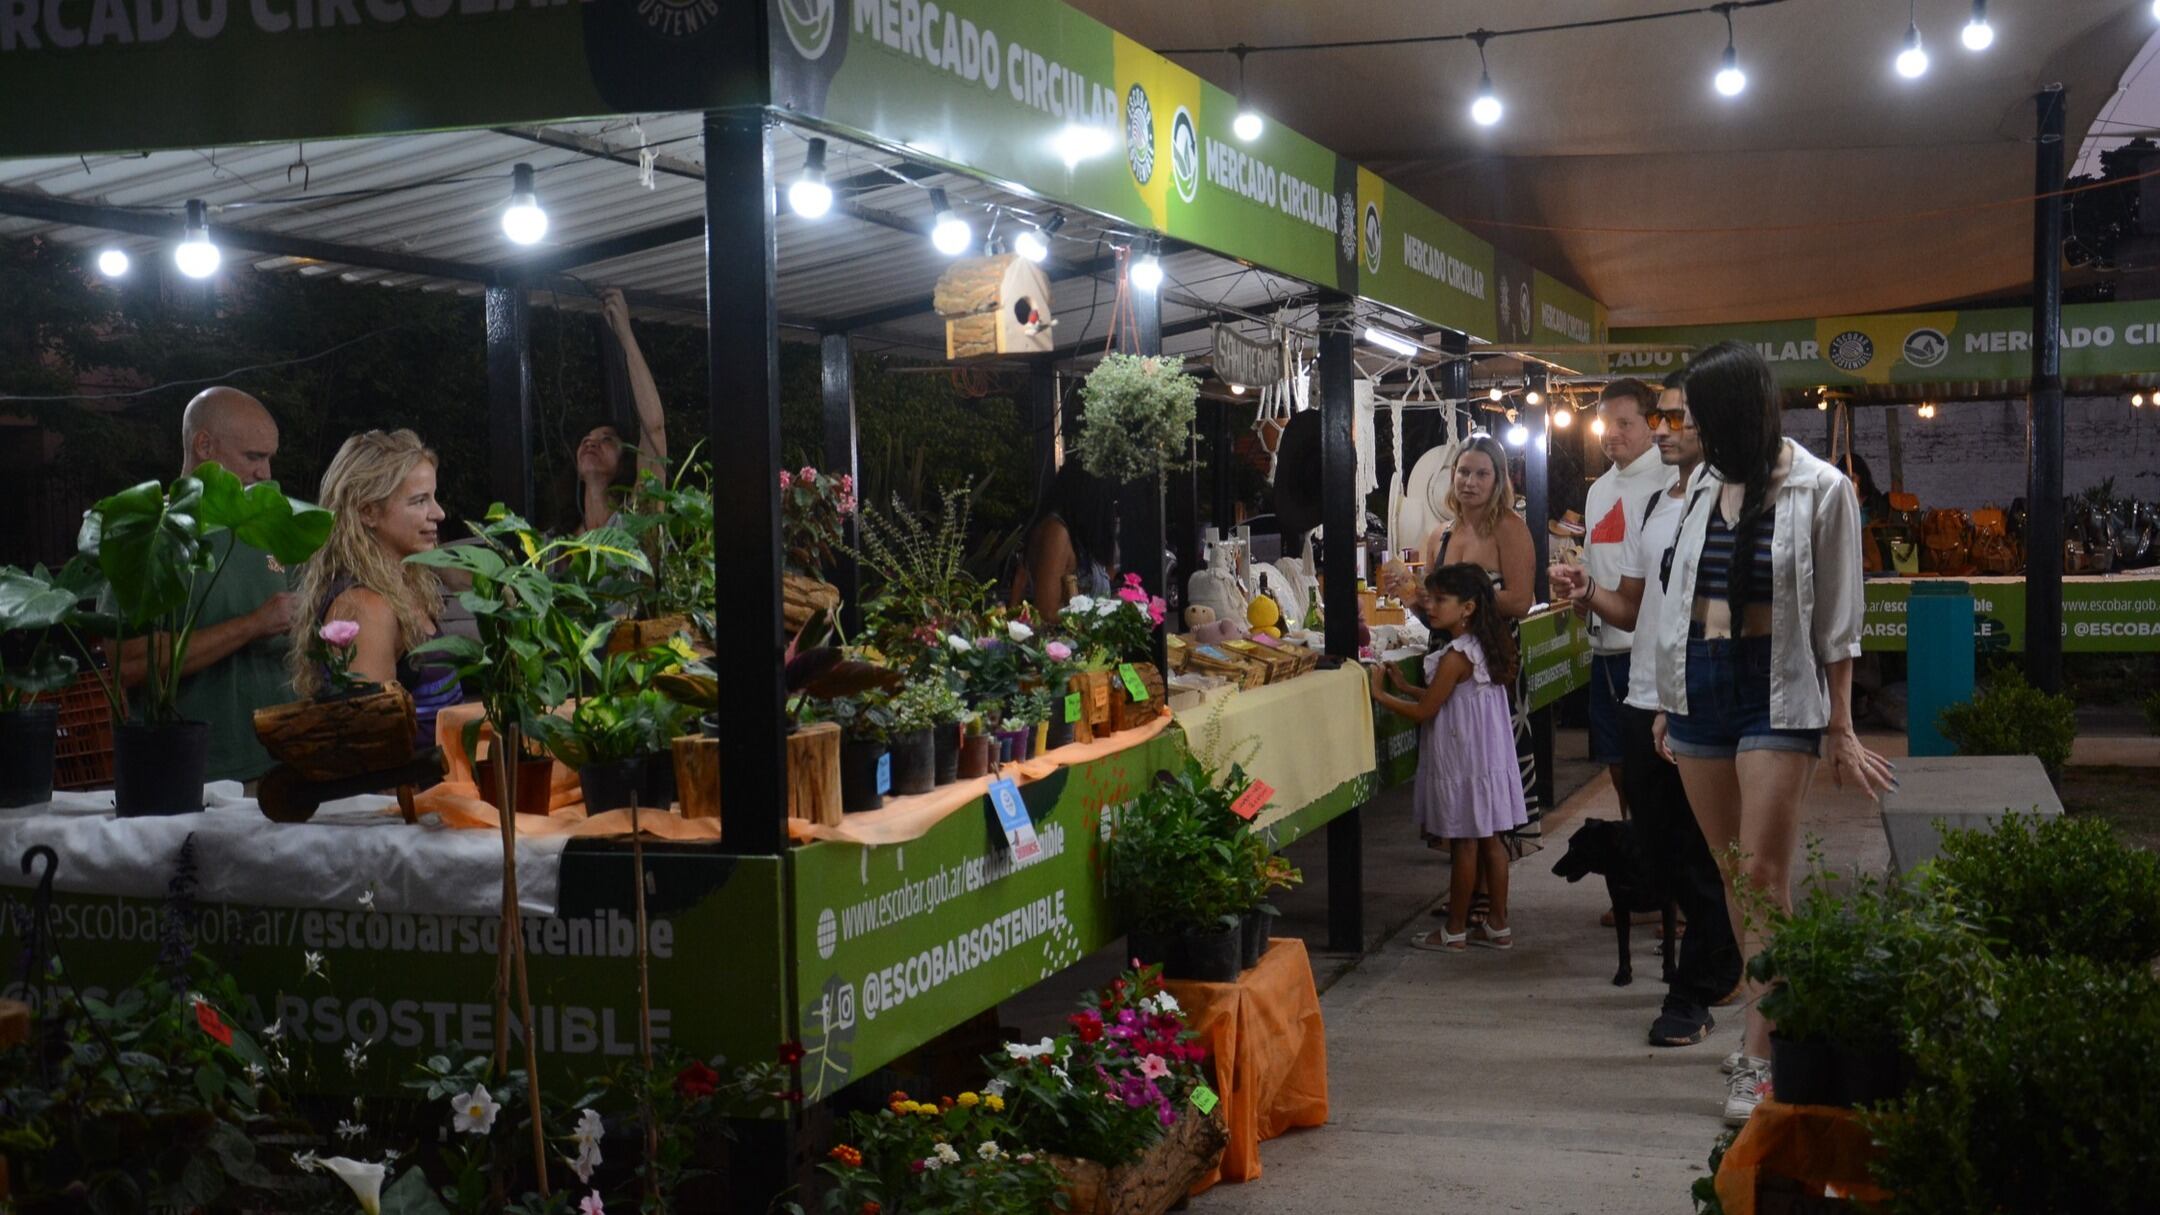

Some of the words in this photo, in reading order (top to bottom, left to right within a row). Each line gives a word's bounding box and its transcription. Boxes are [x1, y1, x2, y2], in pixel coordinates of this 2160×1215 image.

[853, 0, 1000, 91] MERCADO
[1206, 136, 1277, 208] MERCADO
[1280, 171, 1338, 234] CIRCULAR
[1404, 232, 1446, 282] MERCADO
[1447, 255, 1485, 300] CIRCULAR
[1965, 326, 2115, 353] MERADO
[2061, 597, 2160, 613] www.escobar.gob.
[862, 890, 1065, 1021] @ESCOBARSOSTENIBLE
